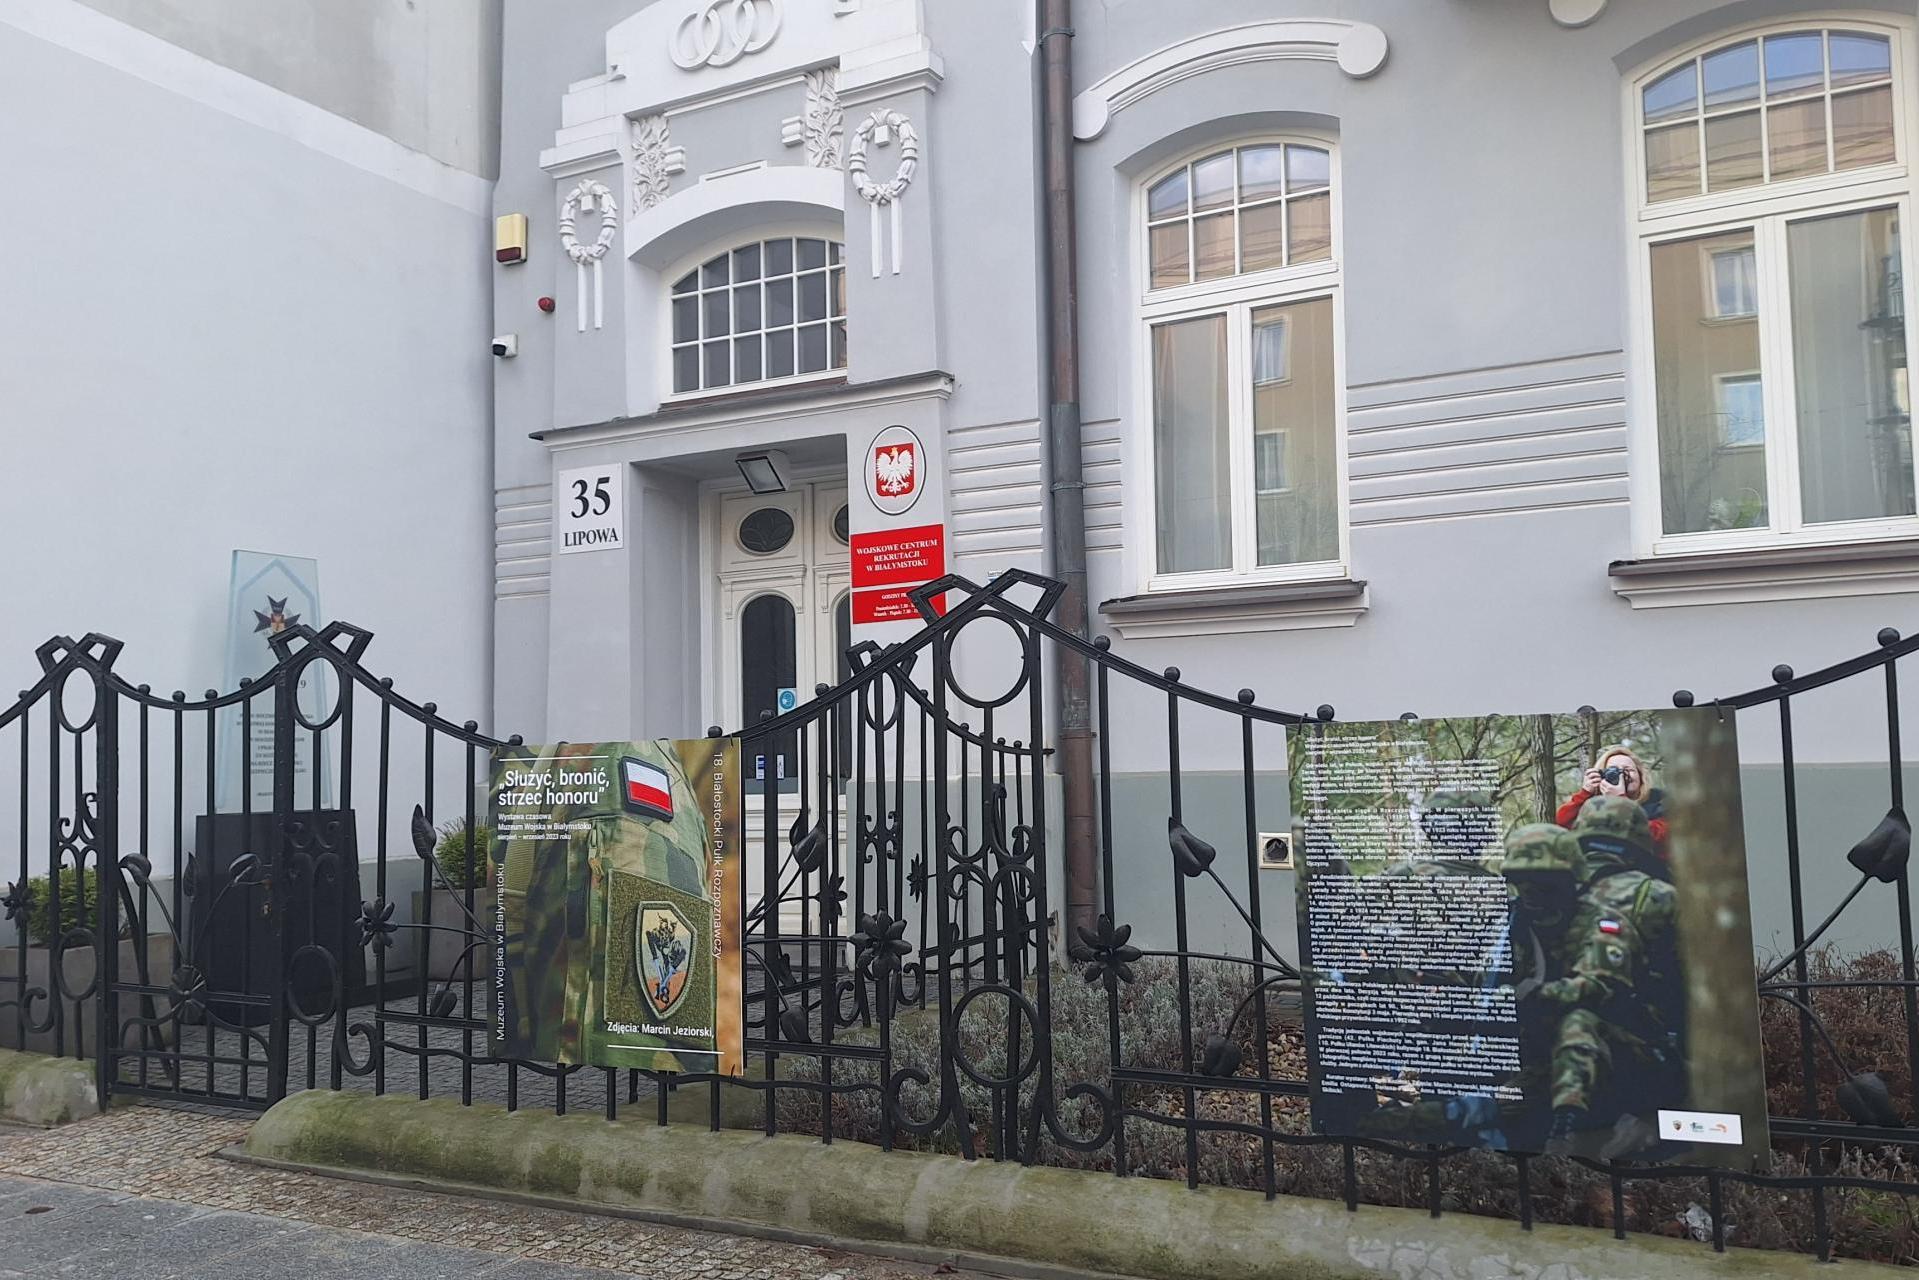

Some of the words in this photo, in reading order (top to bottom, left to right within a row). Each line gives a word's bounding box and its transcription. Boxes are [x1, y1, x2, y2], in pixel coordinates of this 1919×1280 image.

[571, 476, 611, 519] 35
[564, 527, 619, 547] LIPOWA
[856, 543, 899, 555] WOJSKOWE
[900, 539, 938, 550] CENTRUM
[873, 550, 920, 562] REKRUTACJI
[713, 752, 723, 769] 18.
[499, 768, 555, 790] „Służyć,
[559, 767, 610, 788] bronić,
[498, 790, 543, 806] strzec
[713, 772, 724, 837] Białostocki
[497, 813, 525, 822] Wystawa
[497, 823, 524, 831] Muzeum
[524, 822, 546, 832] Wojska
[553, 822, 592, 832] Białymstoku
[713, 840, 724, 866] Pułk
[495, 863, 506, 932] Białymstoku
[711, 869, 723, 959] Rozpoznawczy
[497, 934, 504, 945] w
[495, 947, 506, 988] Wojska
[496, 991, 505, 1040] Muzeum
[607, 1021, 640, 1034] Zdjęcia:
[641, 1023, 671, 1035] Marcin
[672, 1025, 715, 1039] Jeziorski,
